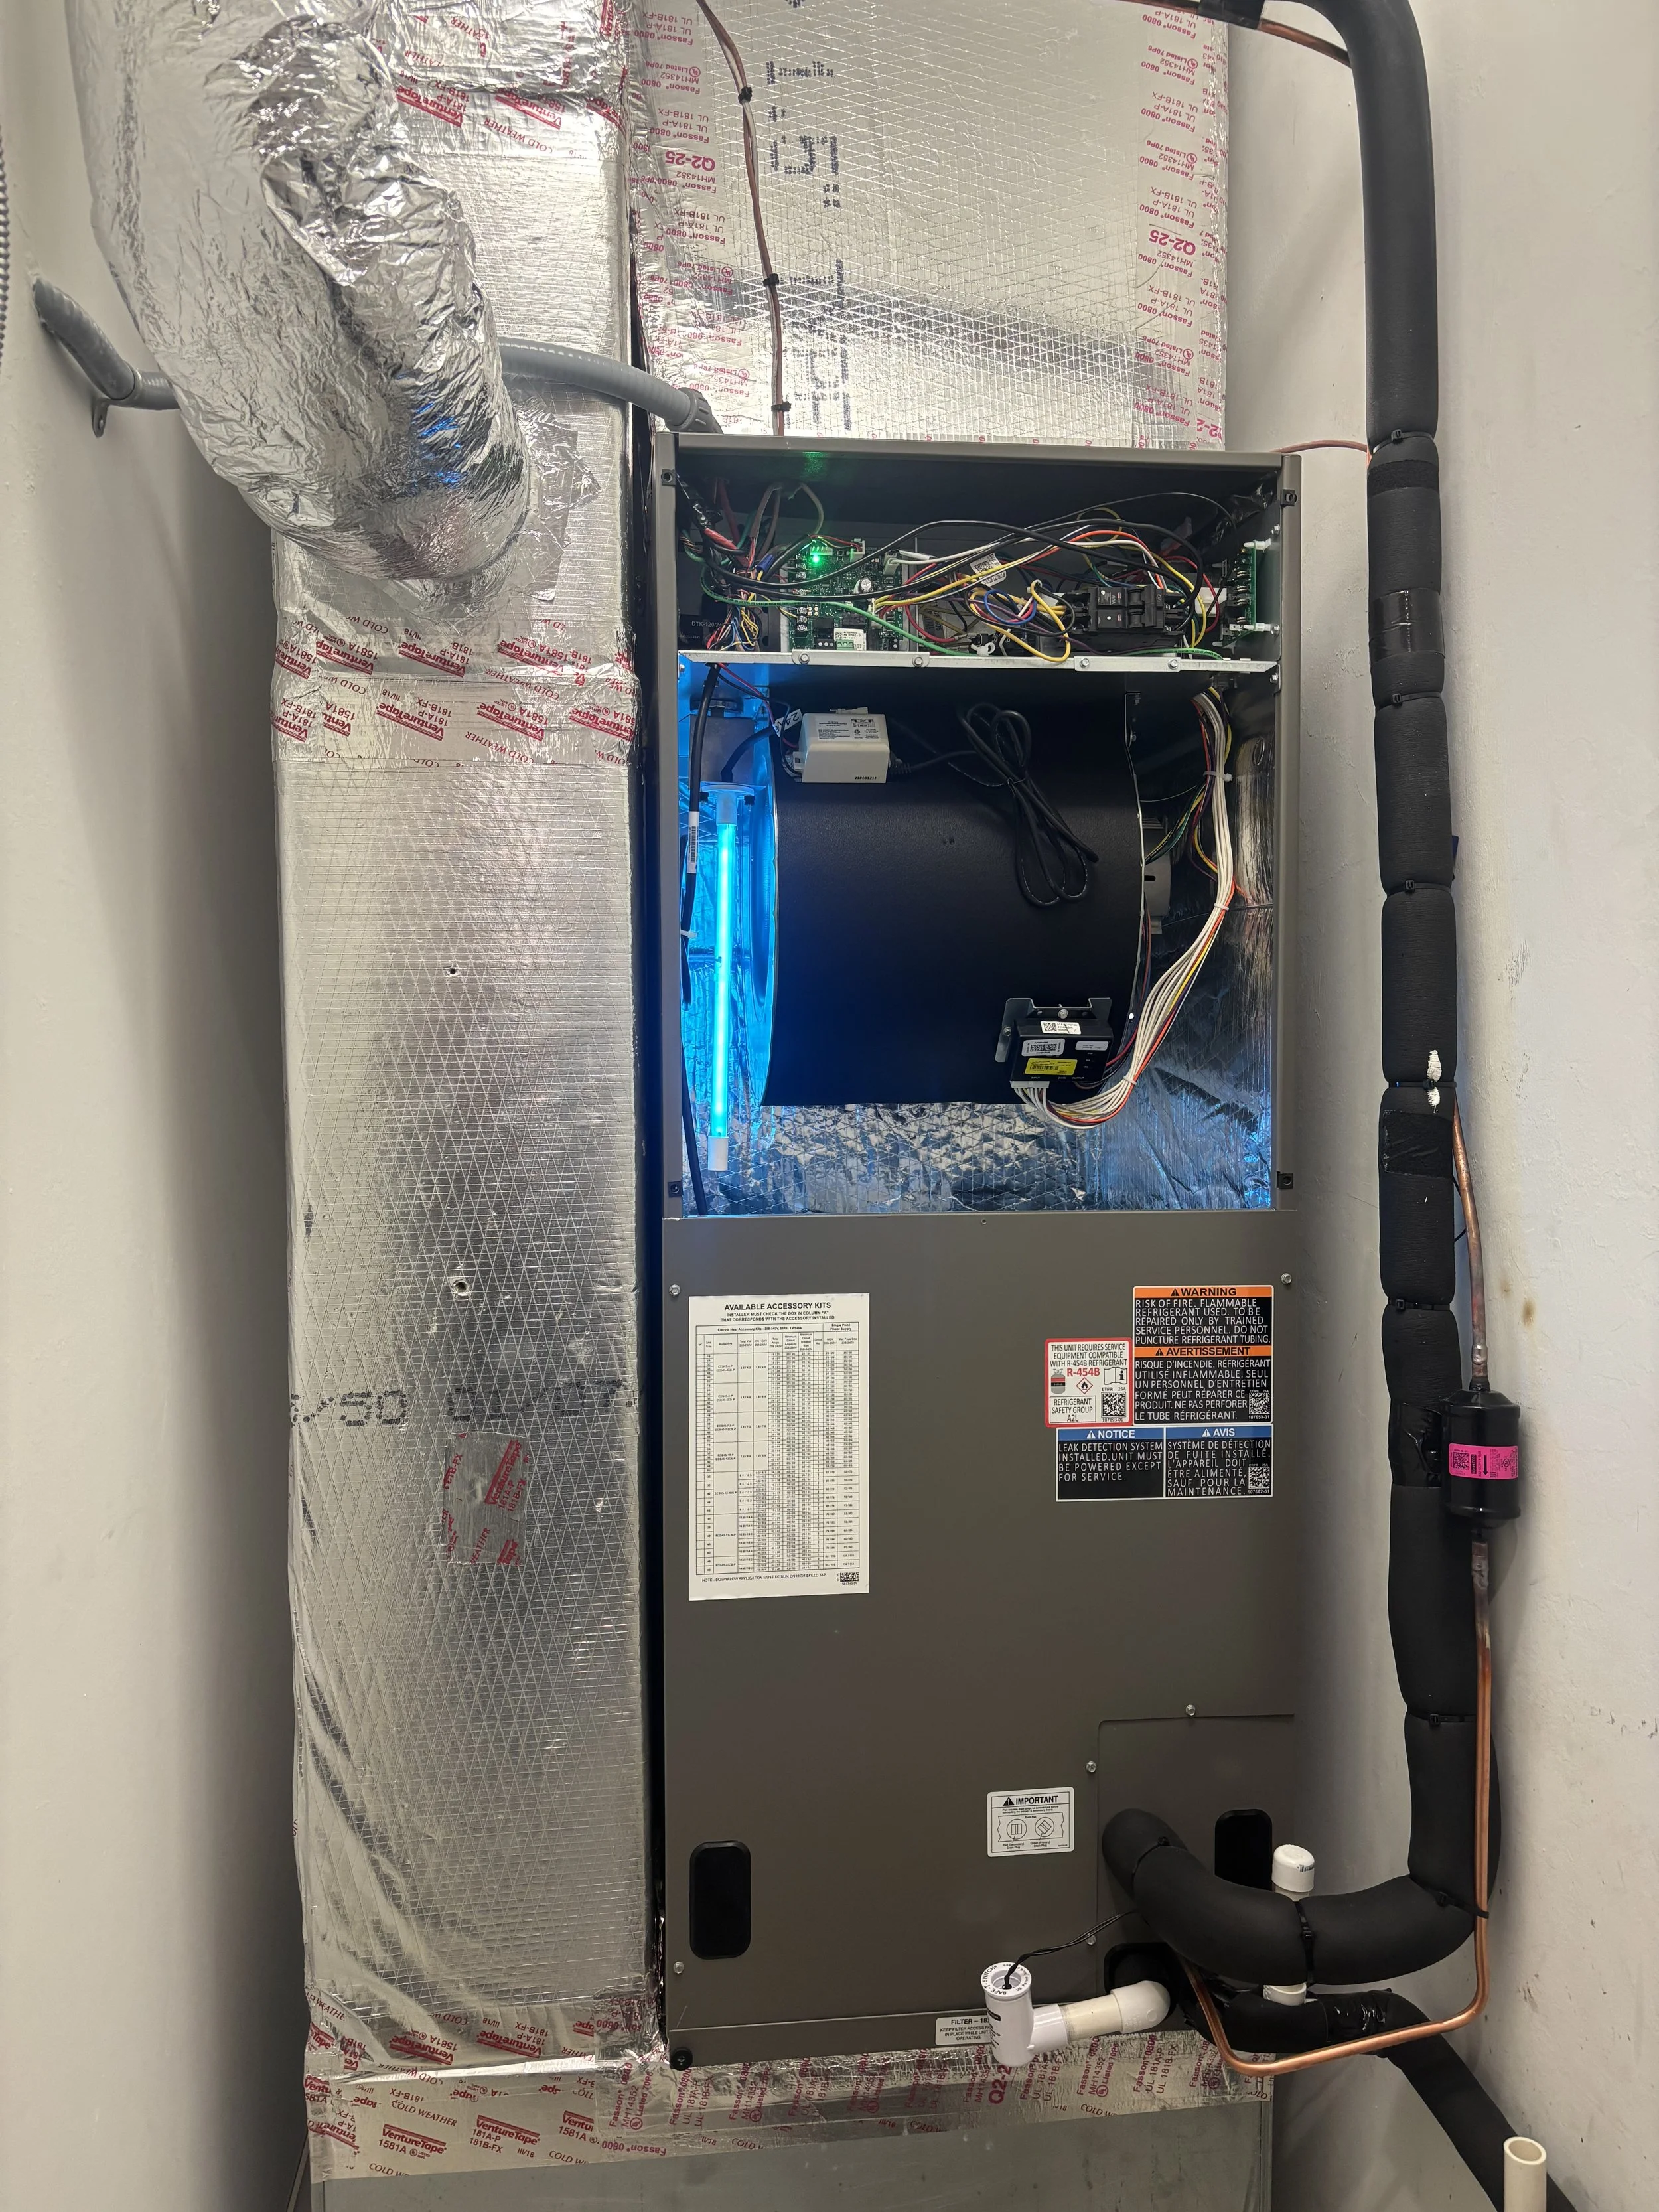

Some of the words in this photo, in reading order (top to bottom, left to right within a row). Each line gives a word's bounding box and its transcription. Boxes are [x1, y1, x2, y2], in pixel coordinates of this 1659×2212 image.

[1141, 61, 1159, 72] 0800
[1160, 58, 1195, 76] MH14352
[1153, 92, 1185, 108] 181B-FX
[1189, 104, 1198, 113] UL
[665, 150, 715, 171] Q2-25
[1149, 230, 1196, 255] Q2-25
[416, 697, 452, 717] 181B-FX
[418, 710, 448, 727] 181A-P
[465, 731, 507, 753] WEATHER
[508, 750, 534, 763] COLD
[1181, 1288, 1236, 1296] WARNING
[1200, 1299, 1256, 1307] FLAMMABLE
[1136, 1308, 1200, 1317] REFRIGERANT
[1182, 1335, 1237, 1344] REFRIGERANT
[1167, 1347, 1250, 1356] AVERTISSEMENT
[1136, 1361, 1164, 1370] RISQUE
[1167, 1360, 1214, 1368] D'INCENDIE.
[1218, 1358, 1270, 1368] RÉFRIGÉRANT
[1067, 1368, 1100, 1376] R-454B
[1136, 1369, 1169, 1379] UTILISÉ
[1173, 1370, 1243, 1379] INFLAMMABLE.
[1136, 1389, 1167, 1400] FORMÉ
[1172, 1390, 1192, 1399] PEUT
[1196, 1388, 1233, 1398] RÉPARER
[1136, 1400, 1172, 1409] PRODUIT.
[1206, 1400, 1248, 1408] PERFORER
[1148, 1412, 1170, 1420] TUBE
[1174, 1409, 1237, 1420] RÉFRIGÉRANT.
[1098, 1430, 1135, 1439] NOTICE
[1059, 1443, 1079, 1452] LEAK
[1082, 1443, 1127, 1451] DETECTION
[1131, 1442, 1163, 1451] SYSTEM
[1168, 1439, 1205, 1450] SYSTÈME
[1208, 1441, 1218, 1449] DE
[1222, 1439, 1271, 1449] DÉTECTION
[1221, 1448, 1271, 1458] INSTALLÉ.
[1075, 1463, 1121, 1471] POWERED
[1127, 1462, 1161, 1471] EXCEPT
[1168, 1459, 1218, 1468] L'APPAREIL
[1082, 1472, 1126, 1481] SERVICE.
[1168, 1469, 1190, 1479] ÊTRE
[1194, 1467, 1246, 1478] ALIMENTÉ,
[1200, 1478, 1229, 1487] POUR
[1168, 1487, 1245, 1496] MAINTENANCE.
[1016, 1795, 1058, 1805] IMPORTANT
[989, 2065, 1012, 2104] Q2-2
[472, 2129, 502, 2142] 181A-P
[379, 2139, 407, 2154] 1581A
[470, 2137, 503, 2153] 181B-FX
[601, 2141, 624, 2152] 0800
